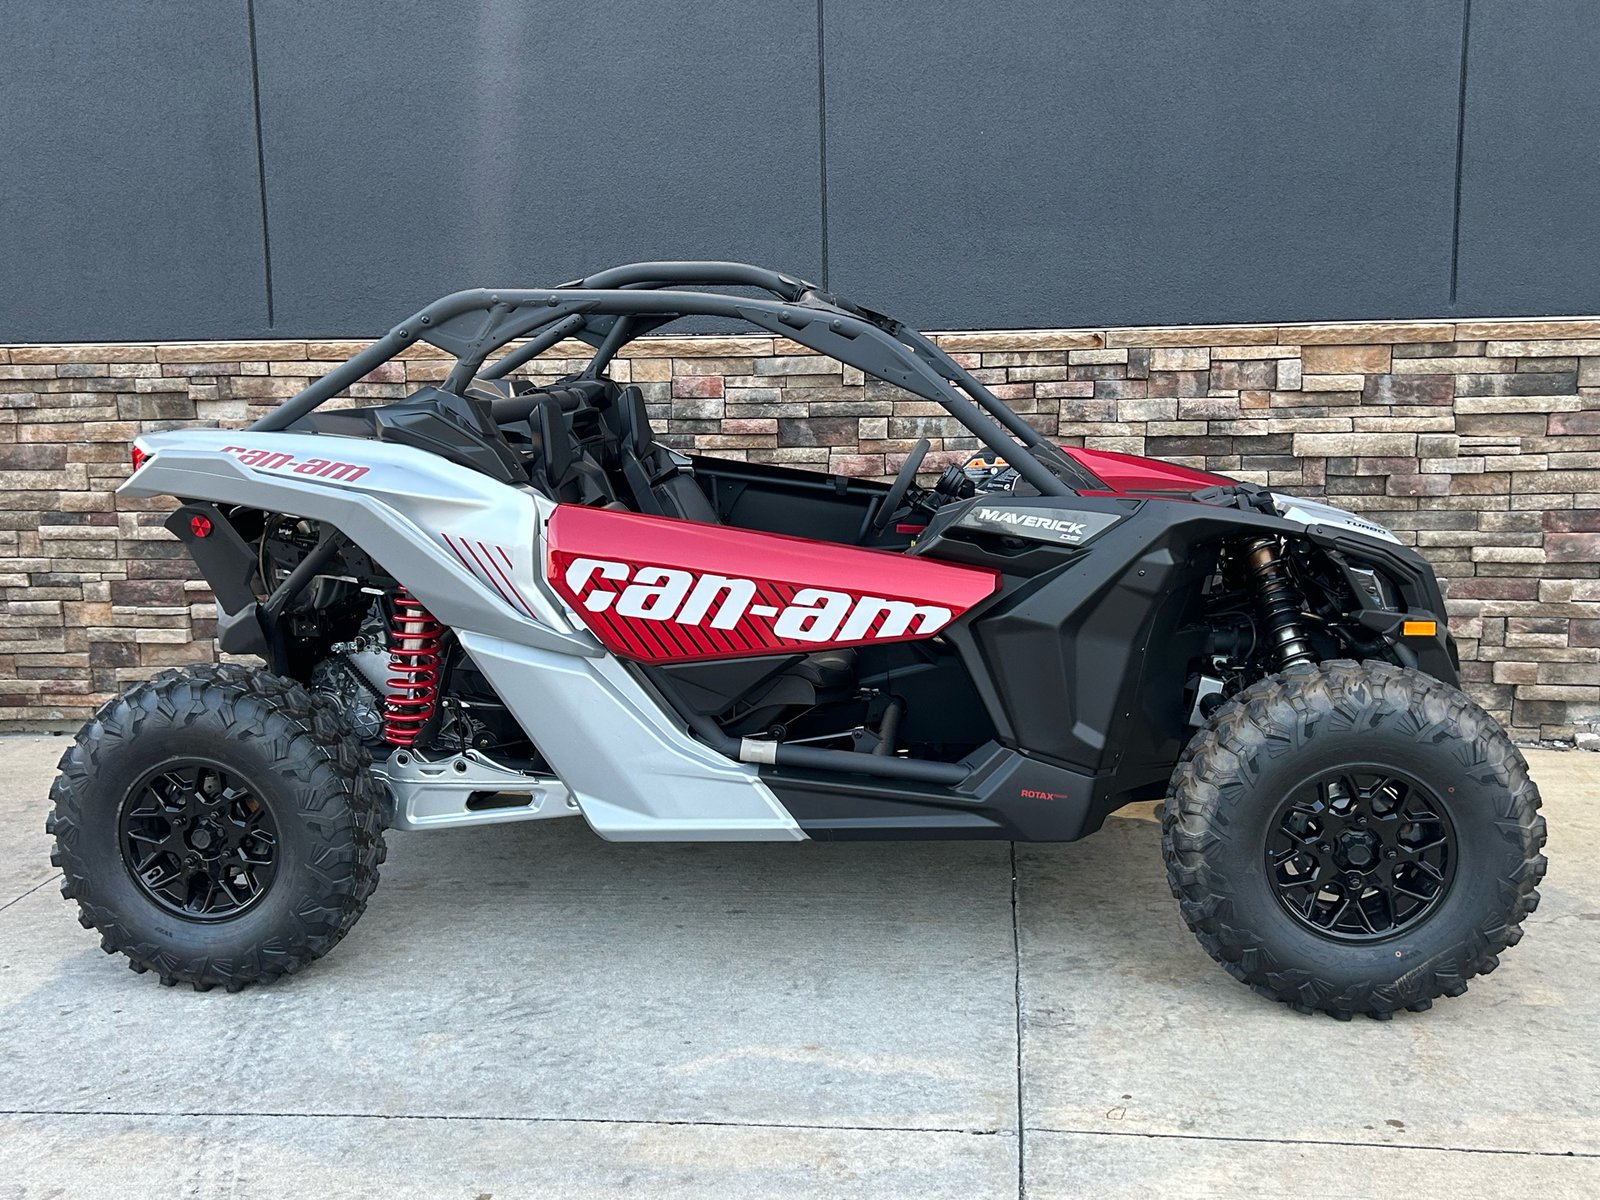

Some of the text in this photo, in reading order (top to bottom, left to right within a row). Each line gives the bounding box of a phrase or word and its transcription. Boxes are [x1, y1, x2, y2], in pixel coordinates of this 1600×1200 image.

[979, 508, 1087, 535] MAVERICK
[1345, 520, 1386, 535] TURBO
[565, 557, 952, 643] can-am
[1021, 789, 1053, 801] ROTAX
